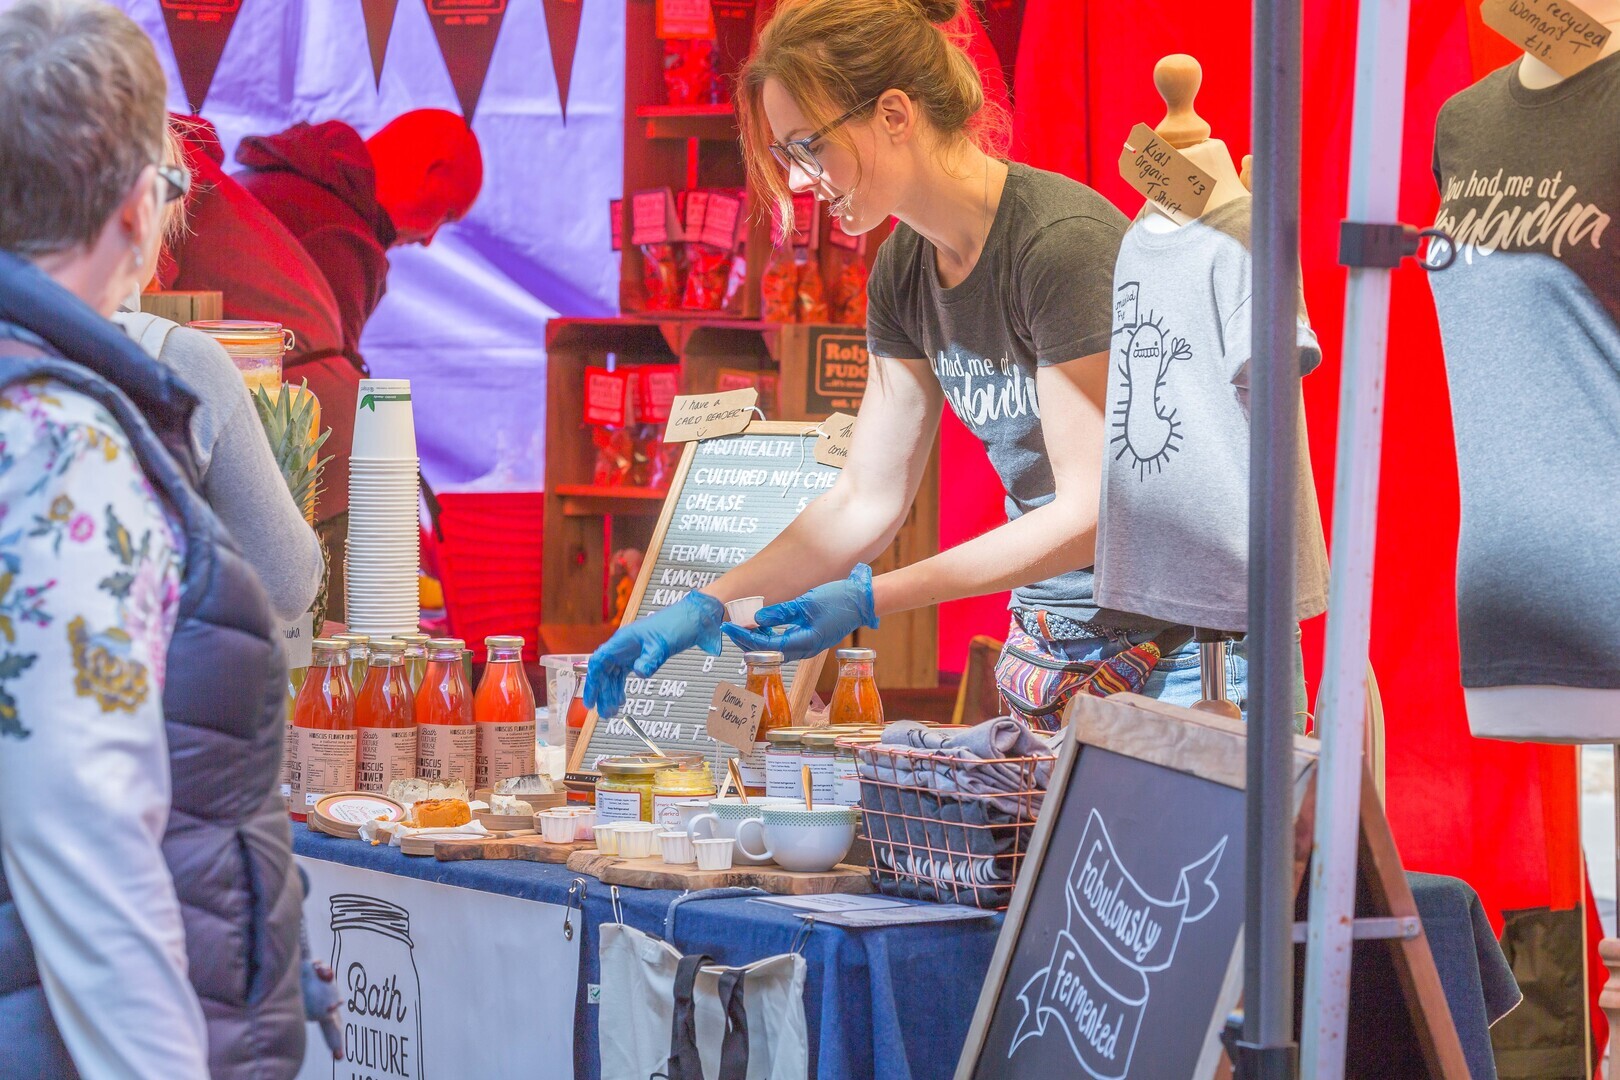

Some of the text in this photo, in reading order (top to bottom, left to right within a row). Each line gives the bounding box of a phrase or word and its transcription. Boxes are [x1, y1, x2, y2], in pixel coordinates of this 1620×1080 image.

[1569, 40, 1592, 54] T
[1147, 181, 1161, 194] T
[1464, 168, 1503, 198] had
[1504, 175, 1533, 198] me
[1537, 170, 1562, 199] at
[940, 350, 966, 377] had
[968, 358, 994, 377] me
[1000, 351, 1012, 377] at
[688, 400, 709, 410] have
[713, 399, 720, 407] a
[675, 408, 741, 426] CARD READER
[702, 439, 795, 457] #GUTHEALTH
[694, 468, 767, 487] CULTURED
[769, 468, 801, 488] NUT
[685, 493, 746, 513] CHEASE
[678, 514, 759, 534] SPRINKLES
[669, 543, 747, 564] FERMENTS
[660, 568, 716, 588] KIMCHI
[702, 656, 715, 673] B
[658, 679, 688, 697] BAG
[663, 700, 676, 718] T
[363, 730, 379, 739] Bath
[421, 728, 437, 736] Bath
[692, 724, 705, 741] T
[358, 773, 384, 782] FLOWER
[416, 768, 441, 779] FLOWER
[358, 783, 384, 792] KOMBUCHA
[1076, 839, 1162, 963] Fabulously
[347, 961, 407, 1024] Bath
[1051, 949, 1124, 1060] Fermented
[345, 1022, 410, 1078] CULTURE
